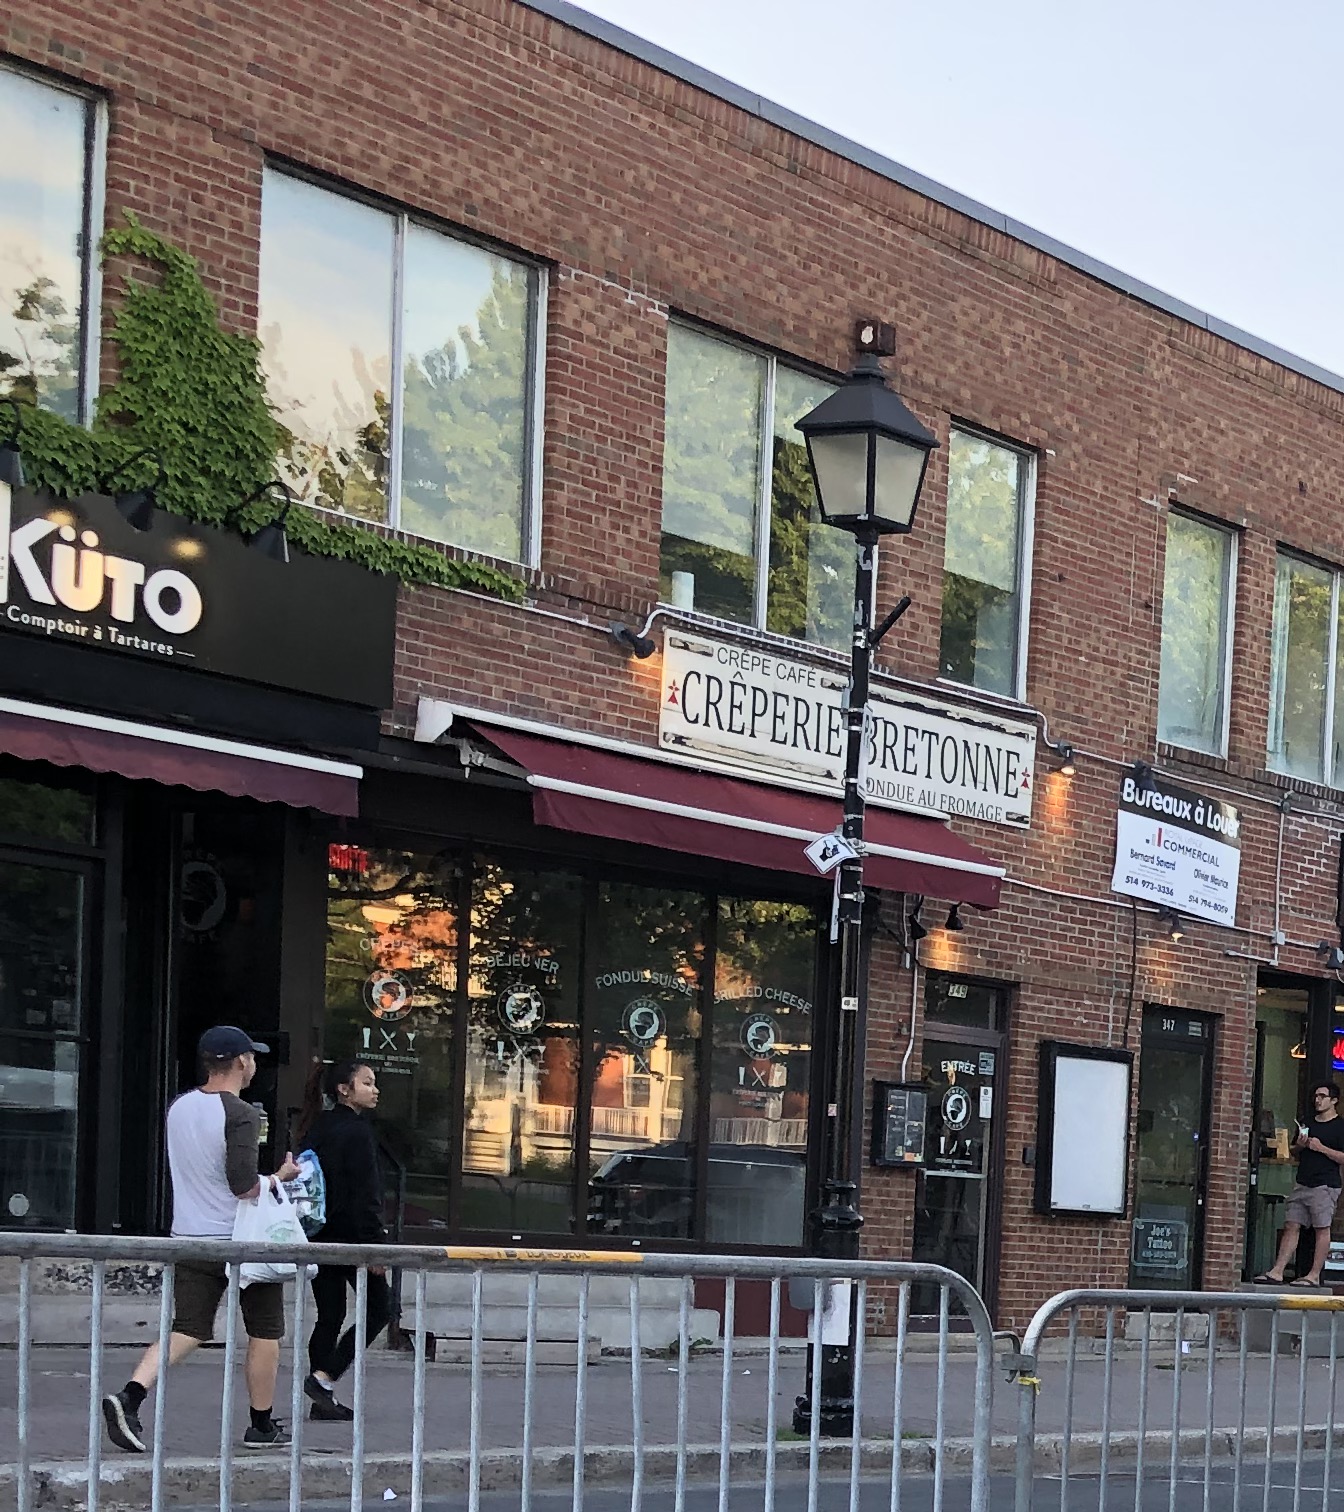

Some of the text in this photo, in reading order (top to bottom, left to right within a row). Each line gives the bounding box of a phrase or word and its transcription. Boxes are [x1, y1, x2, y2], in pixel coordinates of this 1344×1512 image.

[11, 518, 202, 634] KÜTO
[7, 604, 174, 656] Comptoir à Tartares
[717, 646, 817, 689] CRÊPE CAFÉ
[681, 669, 1022, 800] CRÊPERIE BRETONNE
[866, 780, 1004, 822] ONDUE AU FROMAGE
[1122, 778, 1192, 822] Bureaux
[1194, 799, 1204, 826] à
[1206, 805, 1241, 838] Louer
[1163, 840, 1220, 868] COMMERCIAL
[764, 987, 813, 1015] CHEESE
[1162, 1018, 1175, 1031] 347
[940, 1059, 977, 1076] ENTRÉE
